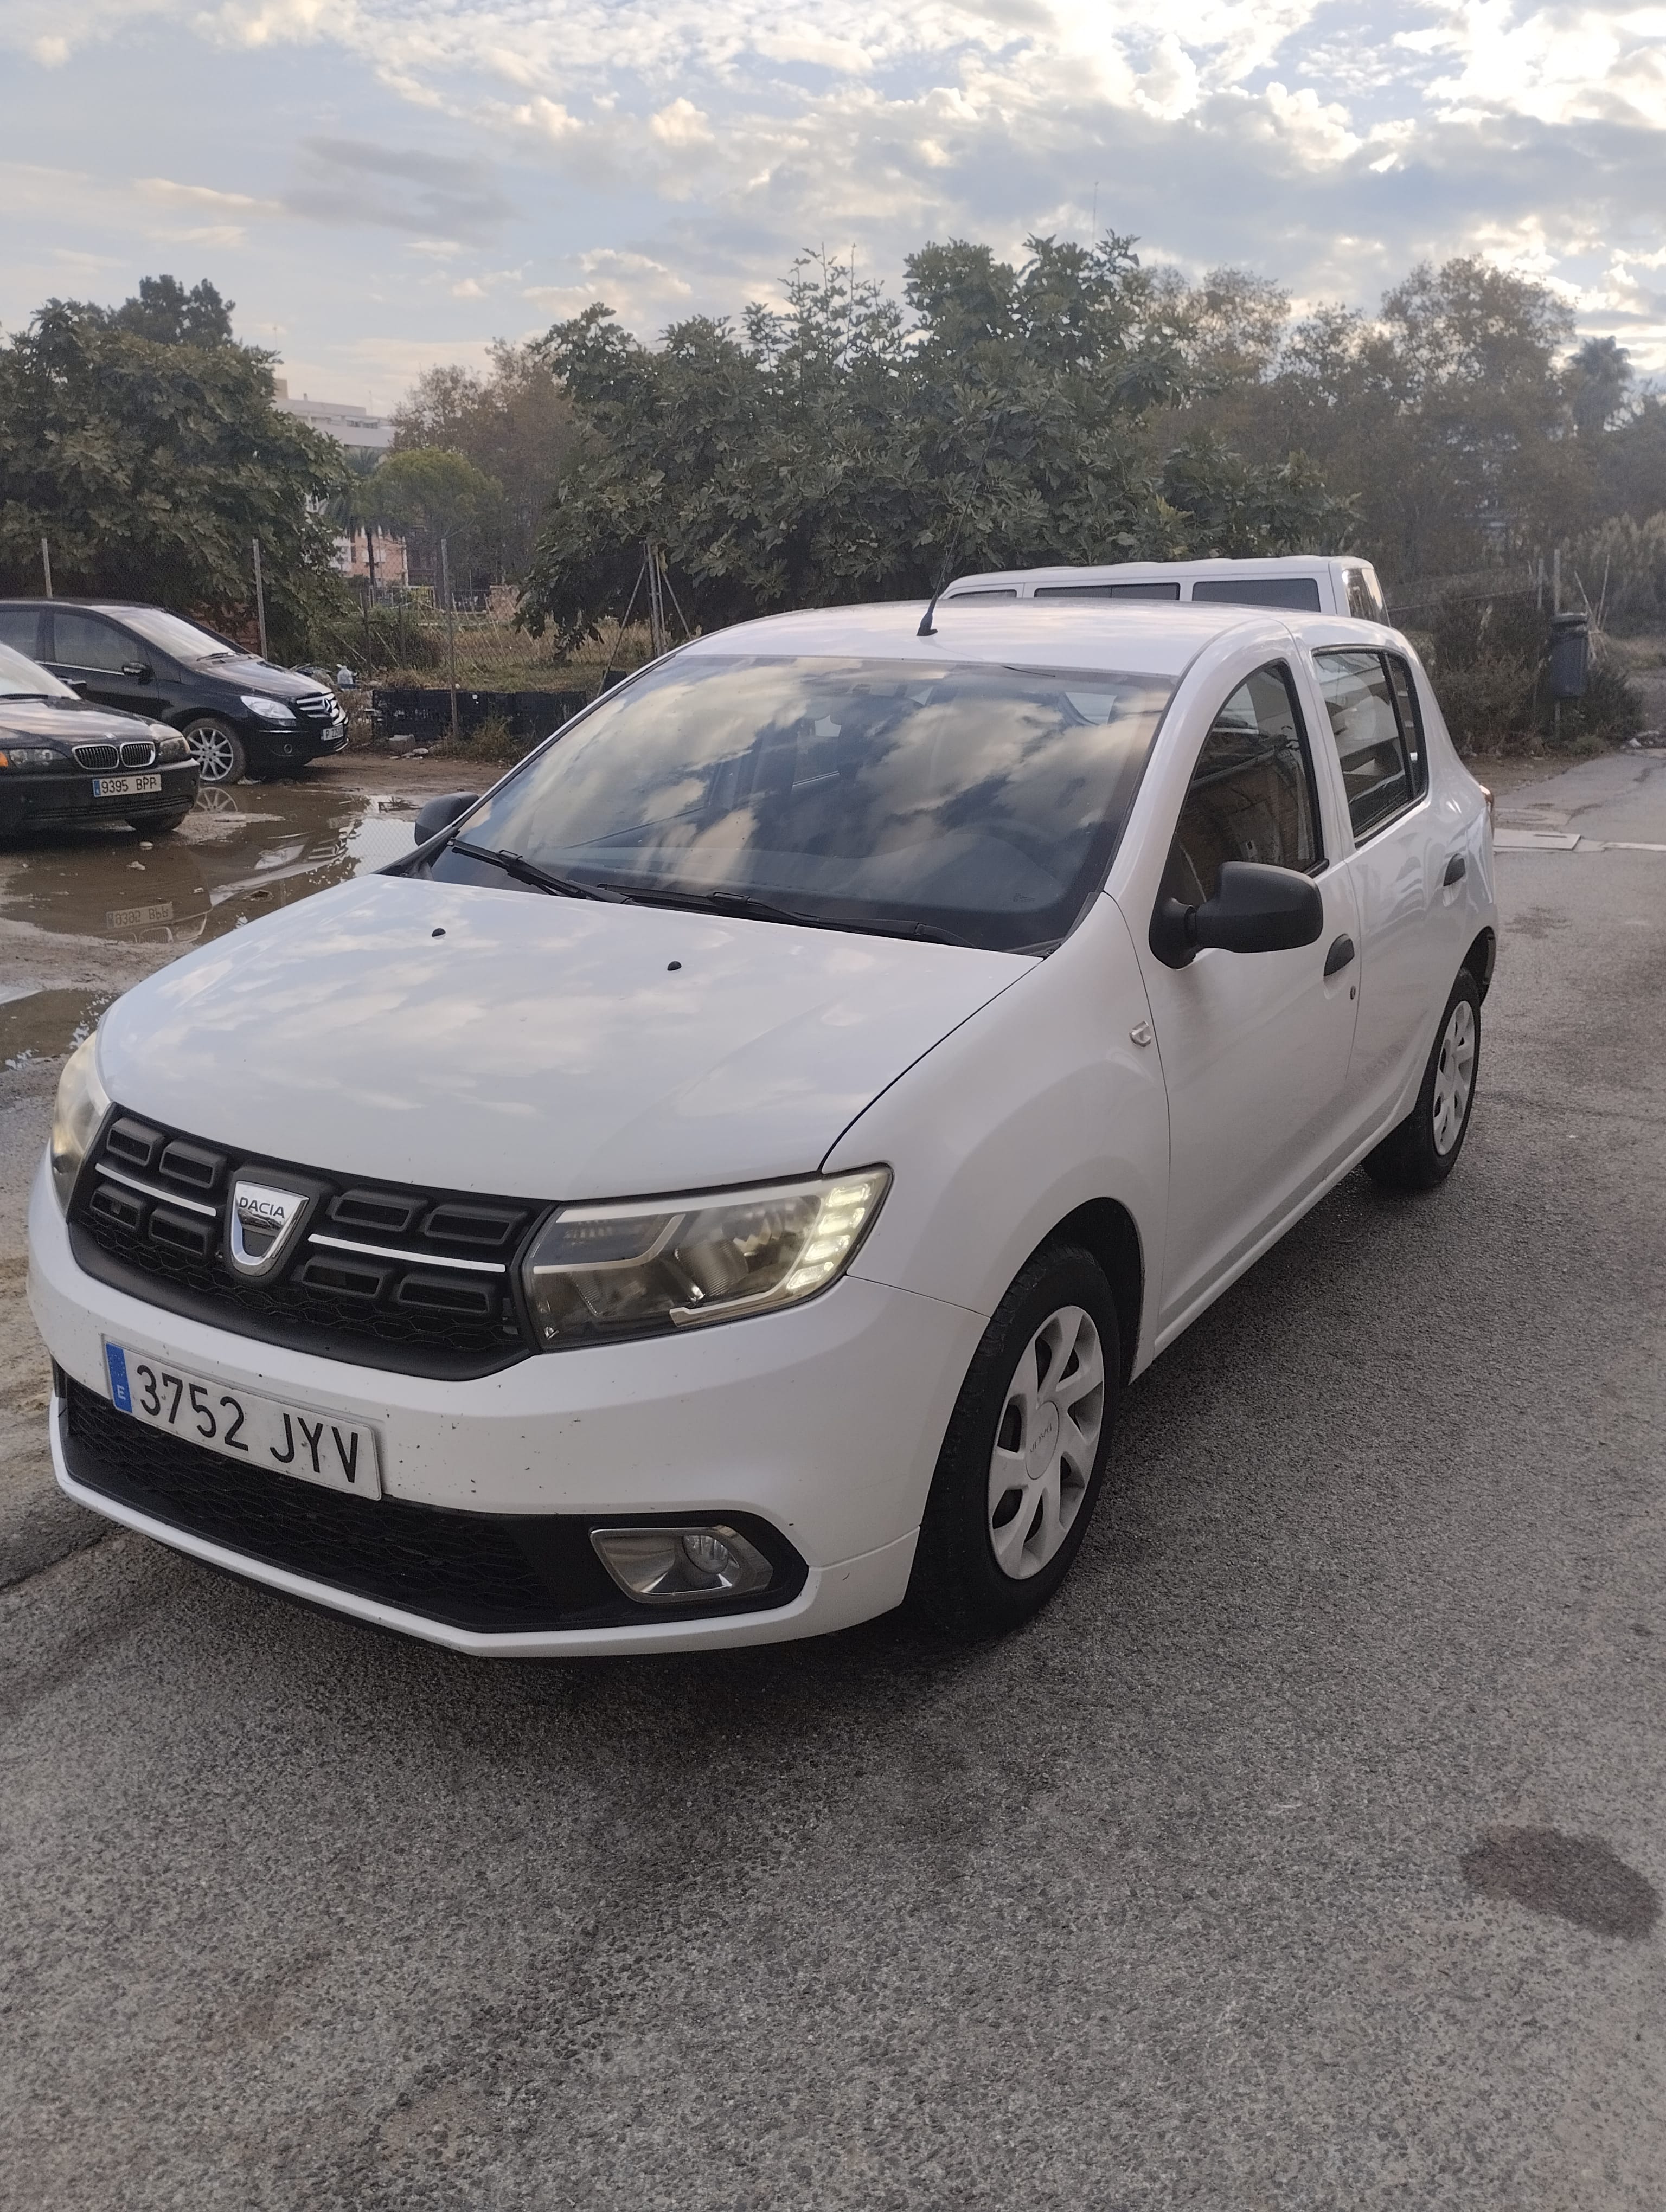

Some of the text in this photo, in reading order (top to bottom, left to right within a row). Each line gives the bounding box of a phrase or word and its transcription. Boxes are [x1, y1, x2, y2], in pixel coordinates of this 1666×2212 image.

[101, 779, 129, 793] 9395
[239, 1197, 285, 1219] DACIA
[117, 1384, 126, 1400] E
[137, 1364, 358, 1483] 3752 JYV
